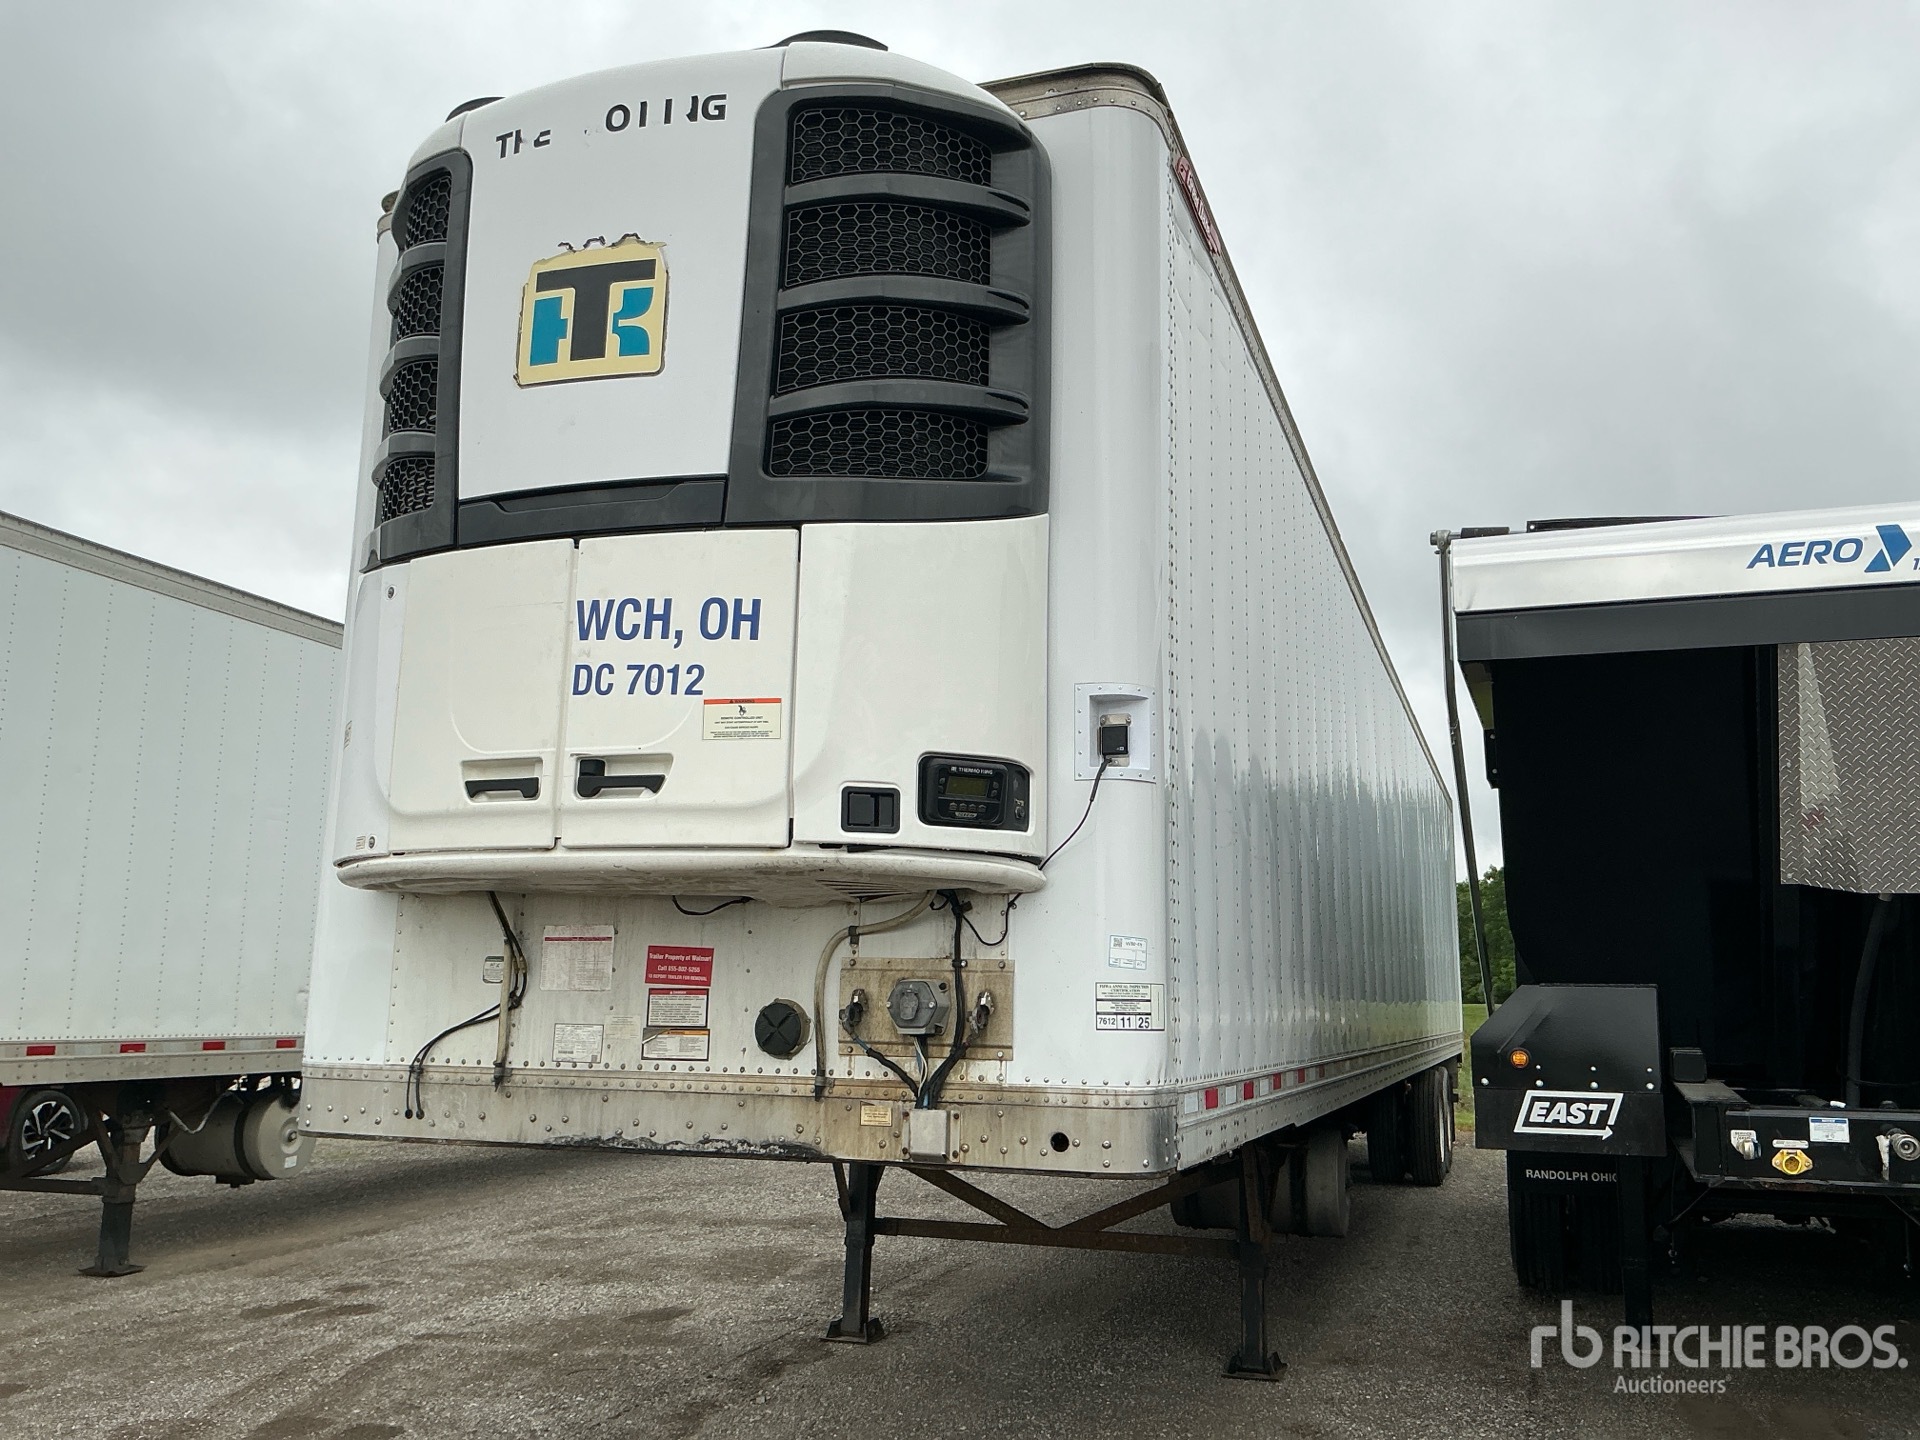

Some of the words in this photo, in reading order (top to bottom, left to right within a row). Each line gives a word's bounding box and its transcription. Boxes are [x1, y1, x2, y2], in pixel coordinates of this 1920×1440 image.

[1746, 538, 1864, 569] AERO
[576, 597, 683, 649] WCH,
[700, 597, 762, 641] OH
[572, 663, 615, 696] DC
[626, 663, 705, 696] 7012
[1098, 1017, 1116, 1025] 7612
[1120, 1016, 1131, 1028] 11
[1138, 1017, 1150, 1028] 25
[1529, 1101, 1608, 1125] EAST
[1525, 1169, 1588, 1181] RANDOLPH
